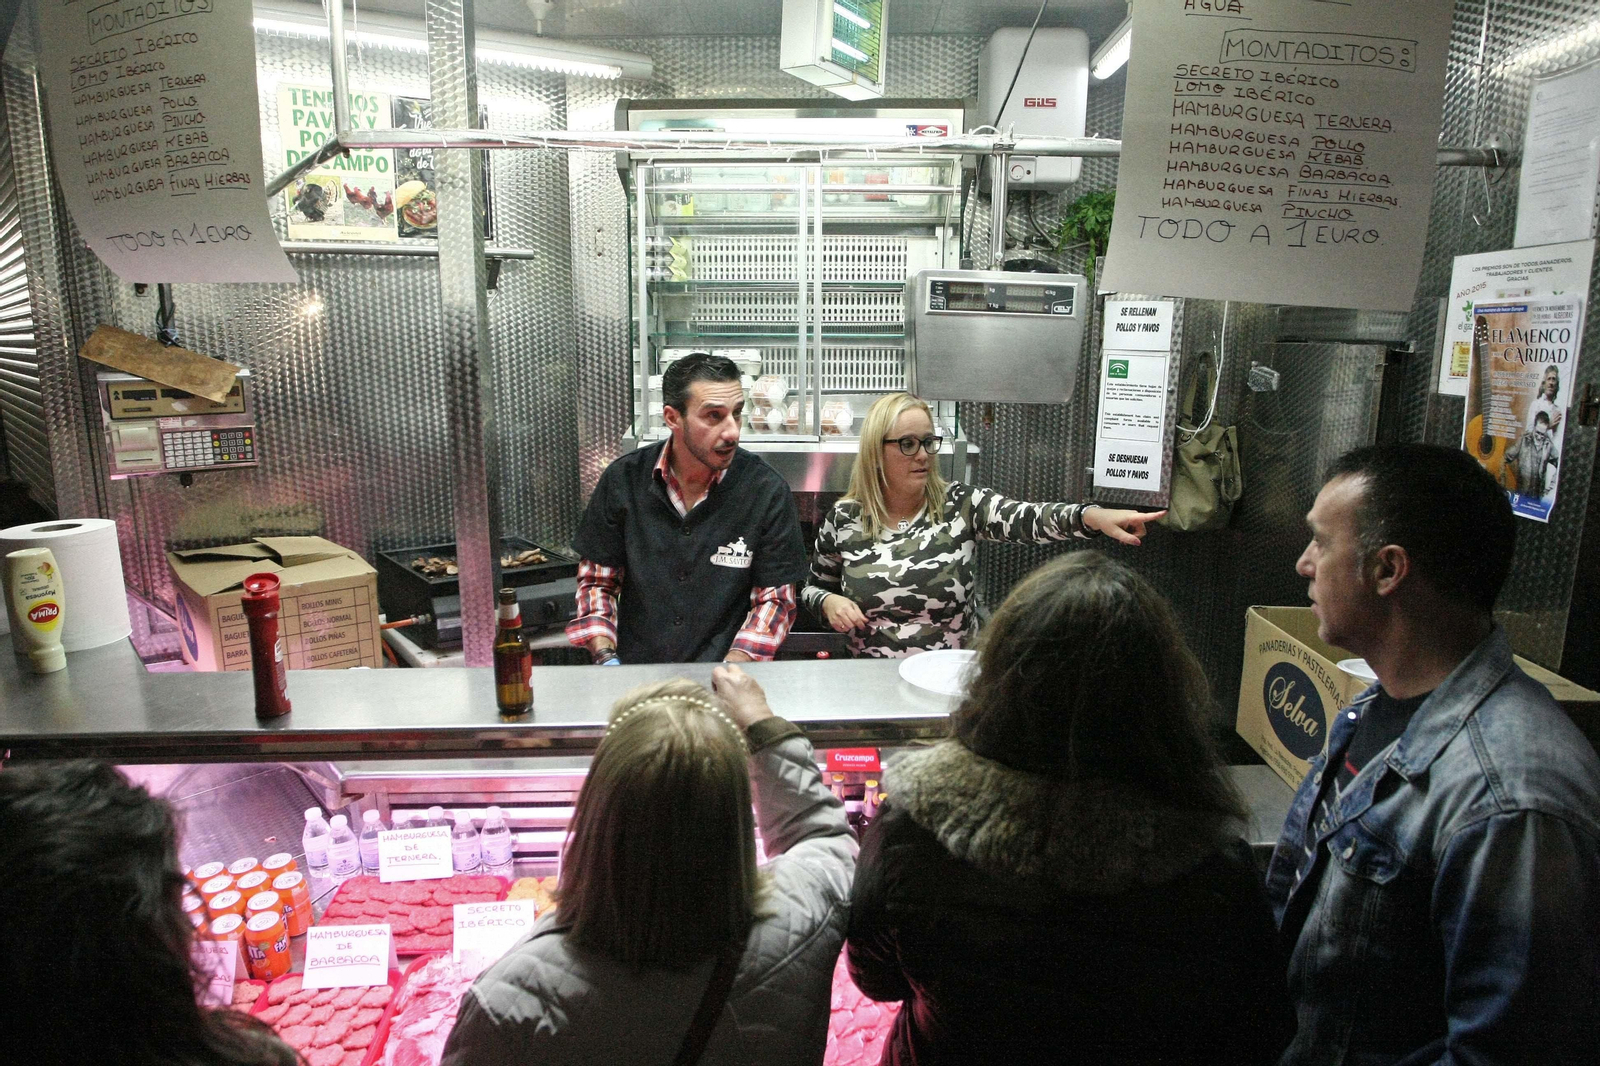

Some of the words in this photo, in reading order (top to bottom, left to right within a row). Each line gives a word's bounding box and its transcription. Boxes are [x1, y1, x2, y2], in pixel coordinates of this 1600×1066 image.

[1184, 0, 1244, 13] AGUA
[70, 47, 127, 68] SECRETO
[71, 72, 109, 90] LOMO
[1176, 64, 1254, 80] SECRETO
[74, 83, 151, 106] HAMBURGUESA
[1175, 81, 1225, 95] LOMO
[288, 88, 379, 113] TENEOS
[76, 105, 152, 127] HAMBURGUESA
[292, 109, 360, 129] PAVS
[1173, 100, 1304, 129] HAMBURGUESA
[78, 122, 155, 149] HAMBURGUESA
[1170, 123, 1299, 148] HAMBURGUESA
[1312, 136, 1366, 153] POLLO
[83, 142, 159, 167] HAMBURGUESA
[1169, 141, 1296, 161] HAMBURGUESA
[323, 152, 389, 173] AMPO
[1167, 160, 1289, 179] HAMBURGUESA
[87, 160, 161, 185] HAMBURGUESA
[93, 179, 164, 206] HAMBURGUESA
[1163, 178, 1273, 196] HAMBURGUESA
[1288, 186, 1329, 201] FINAS
[1162, 197, 1262, 213] HAMBURGUESA
[1282, 203, 1354, 218] PINCHO
[106, 231, 164, 253] TODO
[171, 229, 188, 246] A
[190, 222, 206, 244] 1
[1137, 215, 1236, 243] TODO
[1250, 225, 1271, 246] A
[1286, 220, 1308, 248] 1
[1486, 269, 1523, 277] TRABAJADORES
[1456, 288, 1471, 299] AÑO
[1471, 282, 1487, 293] 2015
[1120, 307, 1128, 316] SE
[1128, 307, 1157, 317] RELLENAN
[1116, 323, 1136, 332] POLLOS
[1142, 323, 1160, 332] PAVOS
[1492, 328, 1571, 347] FLAMENCO
[1503, 348, 1568, 366] CARIDAD
[1108, 453, 1116, 462] SE
[1116, 454, 1149, 464] DESHUESAN
[1105, 468, 1126, 478] POLLOS
[1131, 470, 1149, 480] PAVOS
[25, 590, 56, 600] Mayonesa
[301, 600, 324, 610] BOLLOS
[325, 598, 343, 606] MINIS
[30, 606, 58, 621] PRIMA
[222, 612, 248, 623] BAGUE
[303, 618, 326, 628] BOLLOS
[326, 614, 352, 624] NORMAL
[328, 631, 346, 641] PIÑAS
[226, 649, 249, 659] BARRA
[1259, 640, 1296, 657] PANADERIAS
[1297, 648, 1303, 660] Y
[1303, 653, 1345, 711] PASTELERIAS
[1269, 676, 1319, 737] Selva
[834, 753, 875, 763] Cruzcampo
[382, 830, 450, 844] HAMBURGUESA
[404, 843, 419, 852] DE
[467, 904, 522, 916] SECRETO
[273, 934, 288, 952] FAN
[310, 928, 387, 941] HAMBURGUESA
[336, 942, 353, 951] DE
[310, 954, 380, 966] BARBACOA
